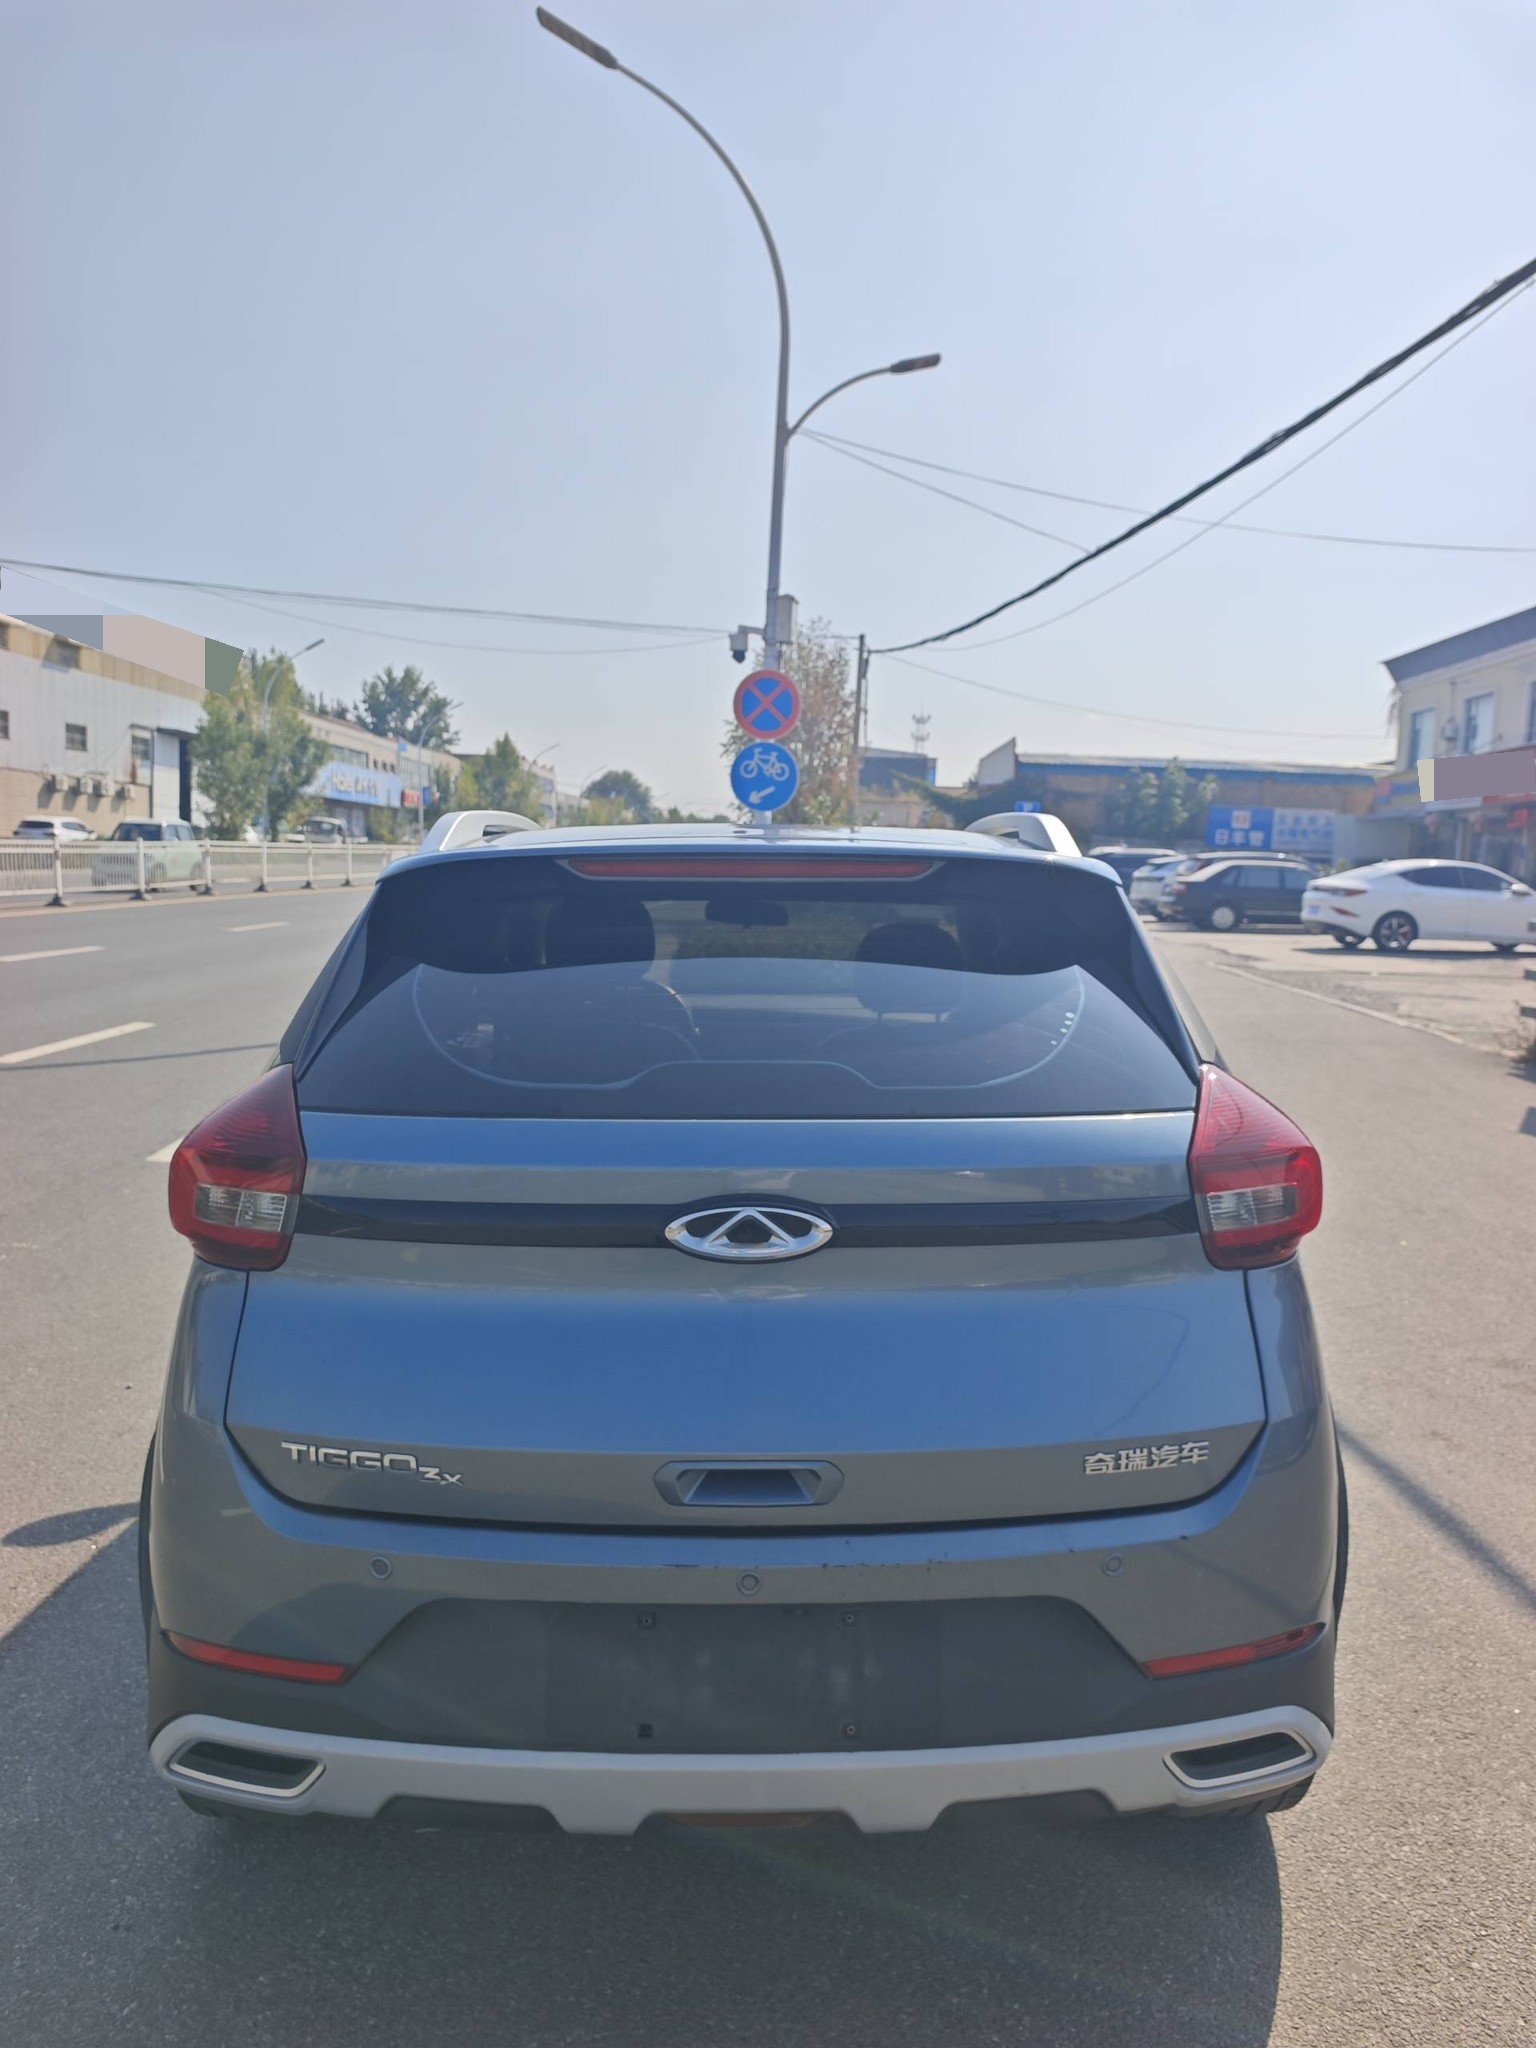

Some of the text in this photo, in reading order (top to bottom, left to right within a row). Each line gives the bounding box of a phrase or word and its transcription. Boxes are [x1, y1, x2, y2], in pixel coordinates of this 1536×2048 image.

[281, 1441, 417, 1472] TIGGO
[1084, 1441, 1210, 1475] 奇瑞汽车
